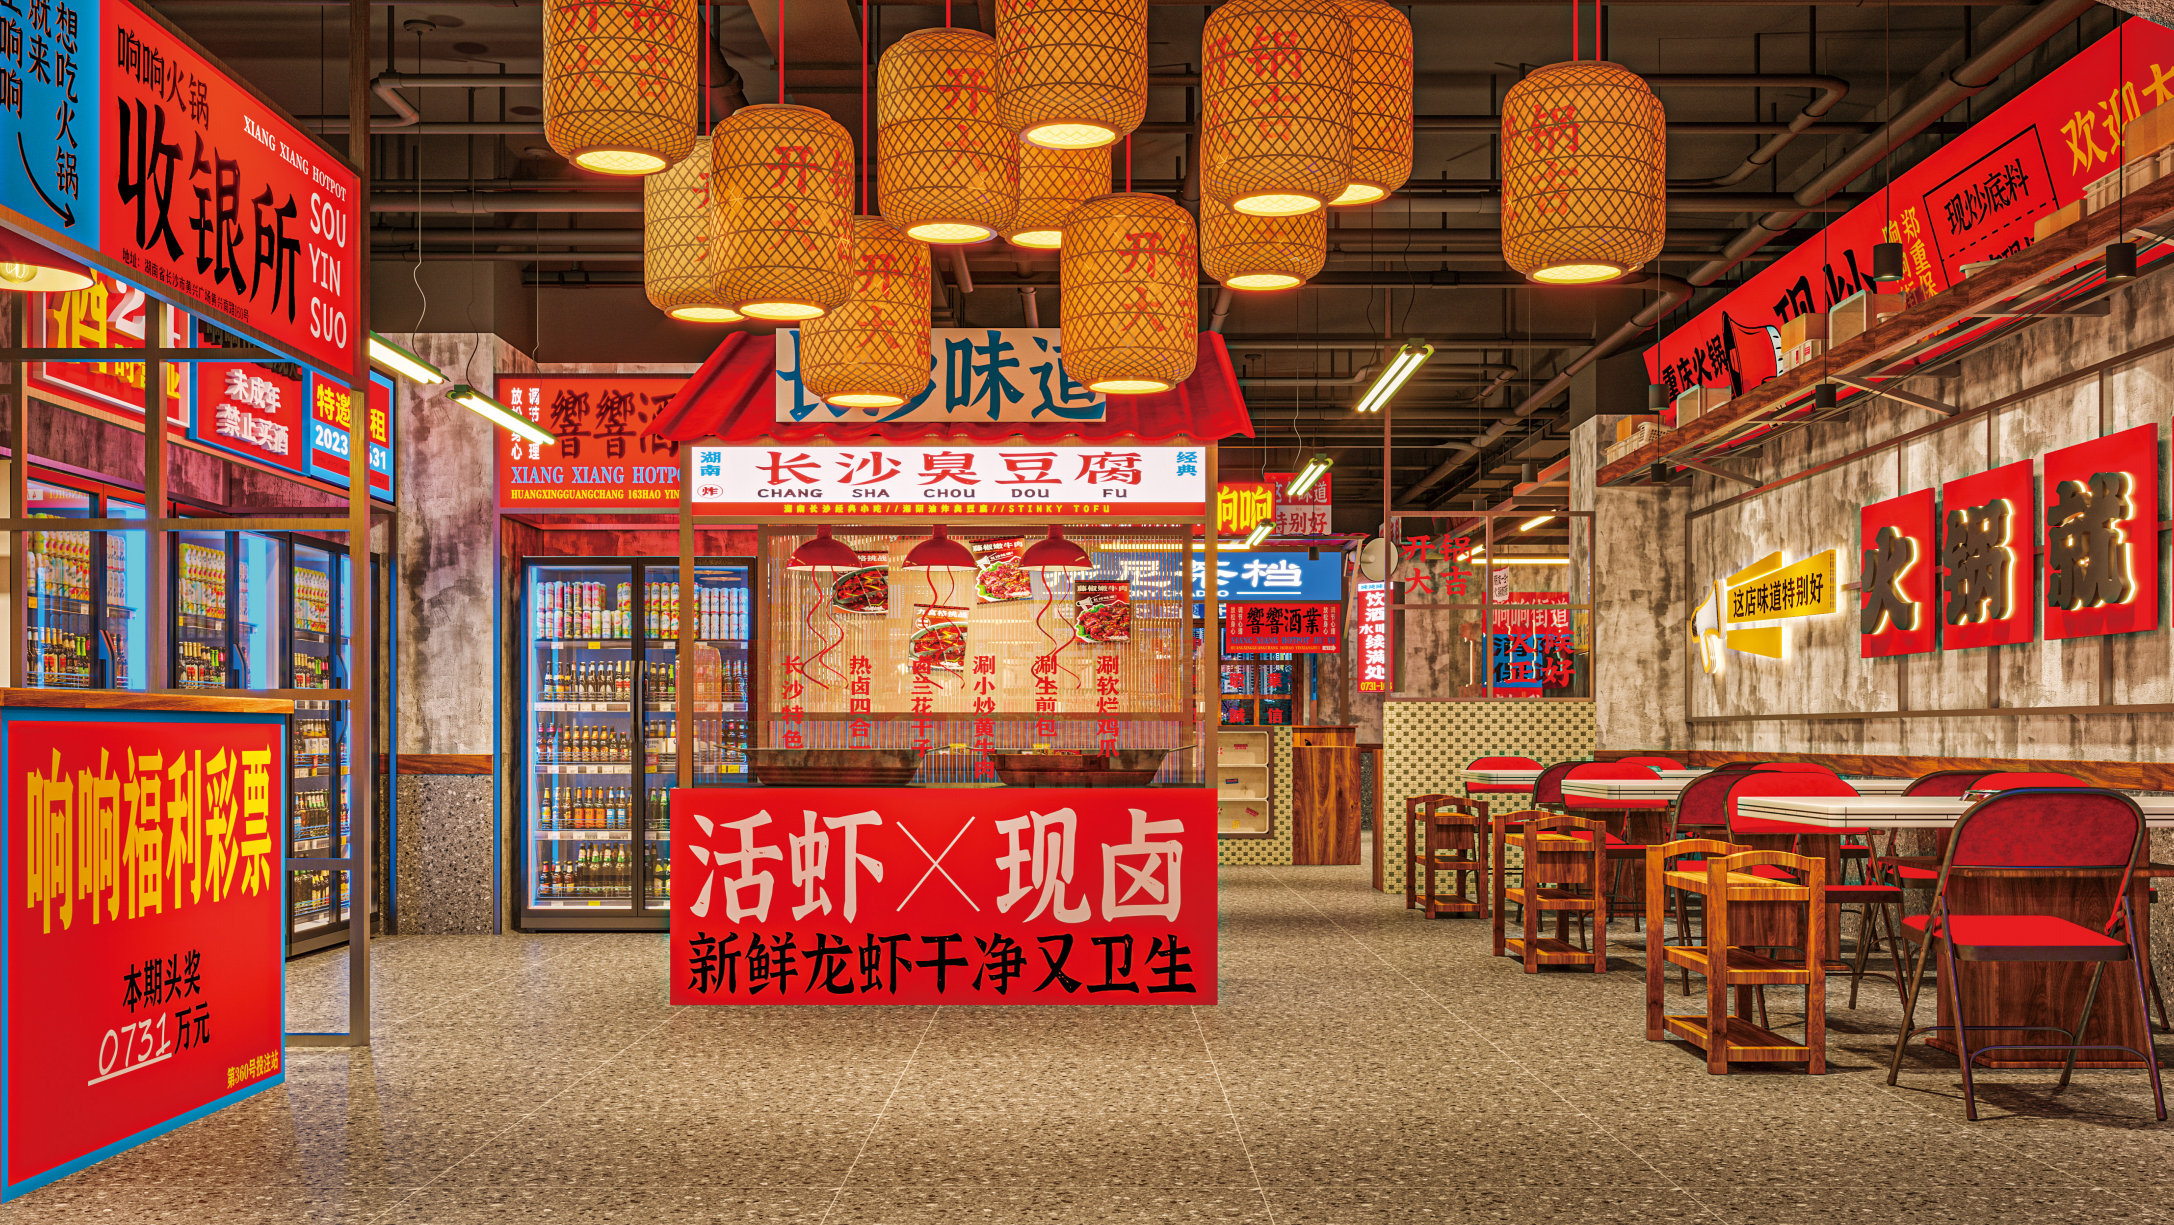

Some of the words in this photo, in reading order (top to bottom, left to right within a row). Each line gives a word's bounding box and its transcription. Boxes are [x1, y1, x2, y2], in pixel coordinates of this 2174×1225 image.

[0, 0, 23, 119] 响响
[117, 24, 209, 131] 响响火锅
[55, 1, 78, 201] 想吃火锅
[243, 115, 276, 151] XIANG
[279, 142, 309, 175] XIANG
[312, 166, 347, 202] HOTPOT
[117, 96, 301, 324] 收银所
[309, 192, 347, 248] SOU
[1944, 158, 2029, 235] 现炒底料
[309, 243, 341, 296] YIN
[310, 296, 347, 349] SUO
[225, 369, 281, 413] 未成年
[776, 330, 1105, 421] 长味道
[215, 404, 288, 455] 禁止买酒
[529, 388, 540, 460] 调节理
[511, 467, 564, 484] XIANG
[572, 467, 625, 484] XIANG
[632, 467, 680, 484] HOTP
[700, 451, 721, 476] 湖南
[755, 451, 1143, 487] 长沙臭豆腐
[1176, 451, 1197, 477] 经典
[511, 489, 624, 499] HUANGXINGGUANGCHANG
[628, 489, 661, 499] 163HAO
[702, 486, 718, 496] 炸
[758, 488, 823, 498] CHANG
[852, 488, 890, 498] SHA
[923, 488, 976, 498] CHOU
[1011, 488, 1050, 498] DOU
[1102, 488, 1127, 498] FU
[1074, 504, 1111, 514] TOFU
[1400, 534, 1472, 563] 开锅
[1404, 566, 1472, 596] 大吉
[1733, 573, 1824, 618] 这店味道特别好
[1246, 607, 1321, 634] 響響酒業
[1035, 656, 1057, 737] 涮生煎包
[1504, 657, 1576, 687] 正好
[782, 656, 804, 749] 长沙特色
[849, 655, 871, 748] 热卤四合一
[973, 656, 995, 778] 涮小炒黄牛肉
[1096, 656, 1120, 757] 涮软烂鸡爪
[27, 743, 272, 935] 响响福利彩票
[123, 949, 201, 1014] 本期头奖
[687, 931, 1198, 995] 新鲜龙虾干净又卫生
[227, 1051, 279, 1090] 第360号投注站
